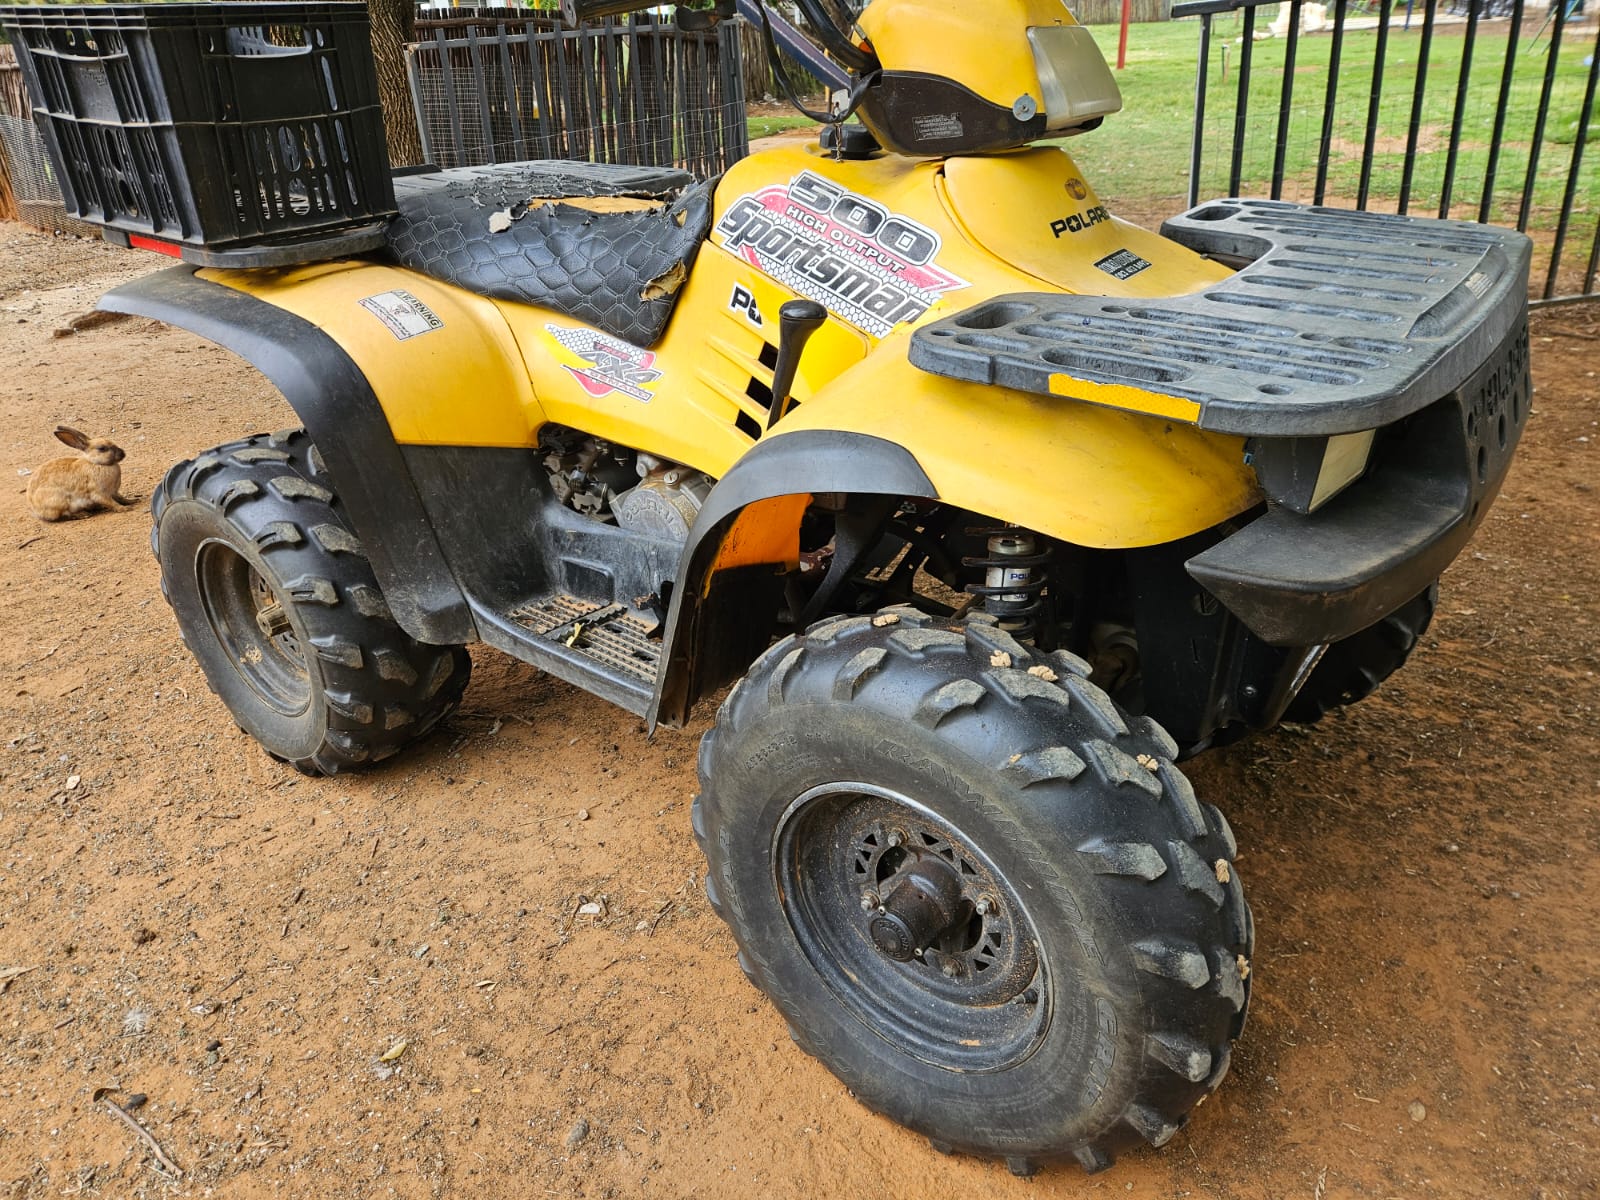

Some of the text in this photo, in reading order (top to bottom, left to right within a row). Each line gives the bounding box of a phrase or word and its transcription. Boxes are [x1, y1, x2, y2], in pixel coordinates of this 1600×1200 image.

[786, 205, 906, 273] HIGH OUTPUT
[787, 171, 938, 267] 500
[1050, 205, 1111, 239] POLAR
[717, 194, 932, 326] Sportsman
[402, 293, 440, 327] WARNING
[590, 371, 651, 398] DEMAND
